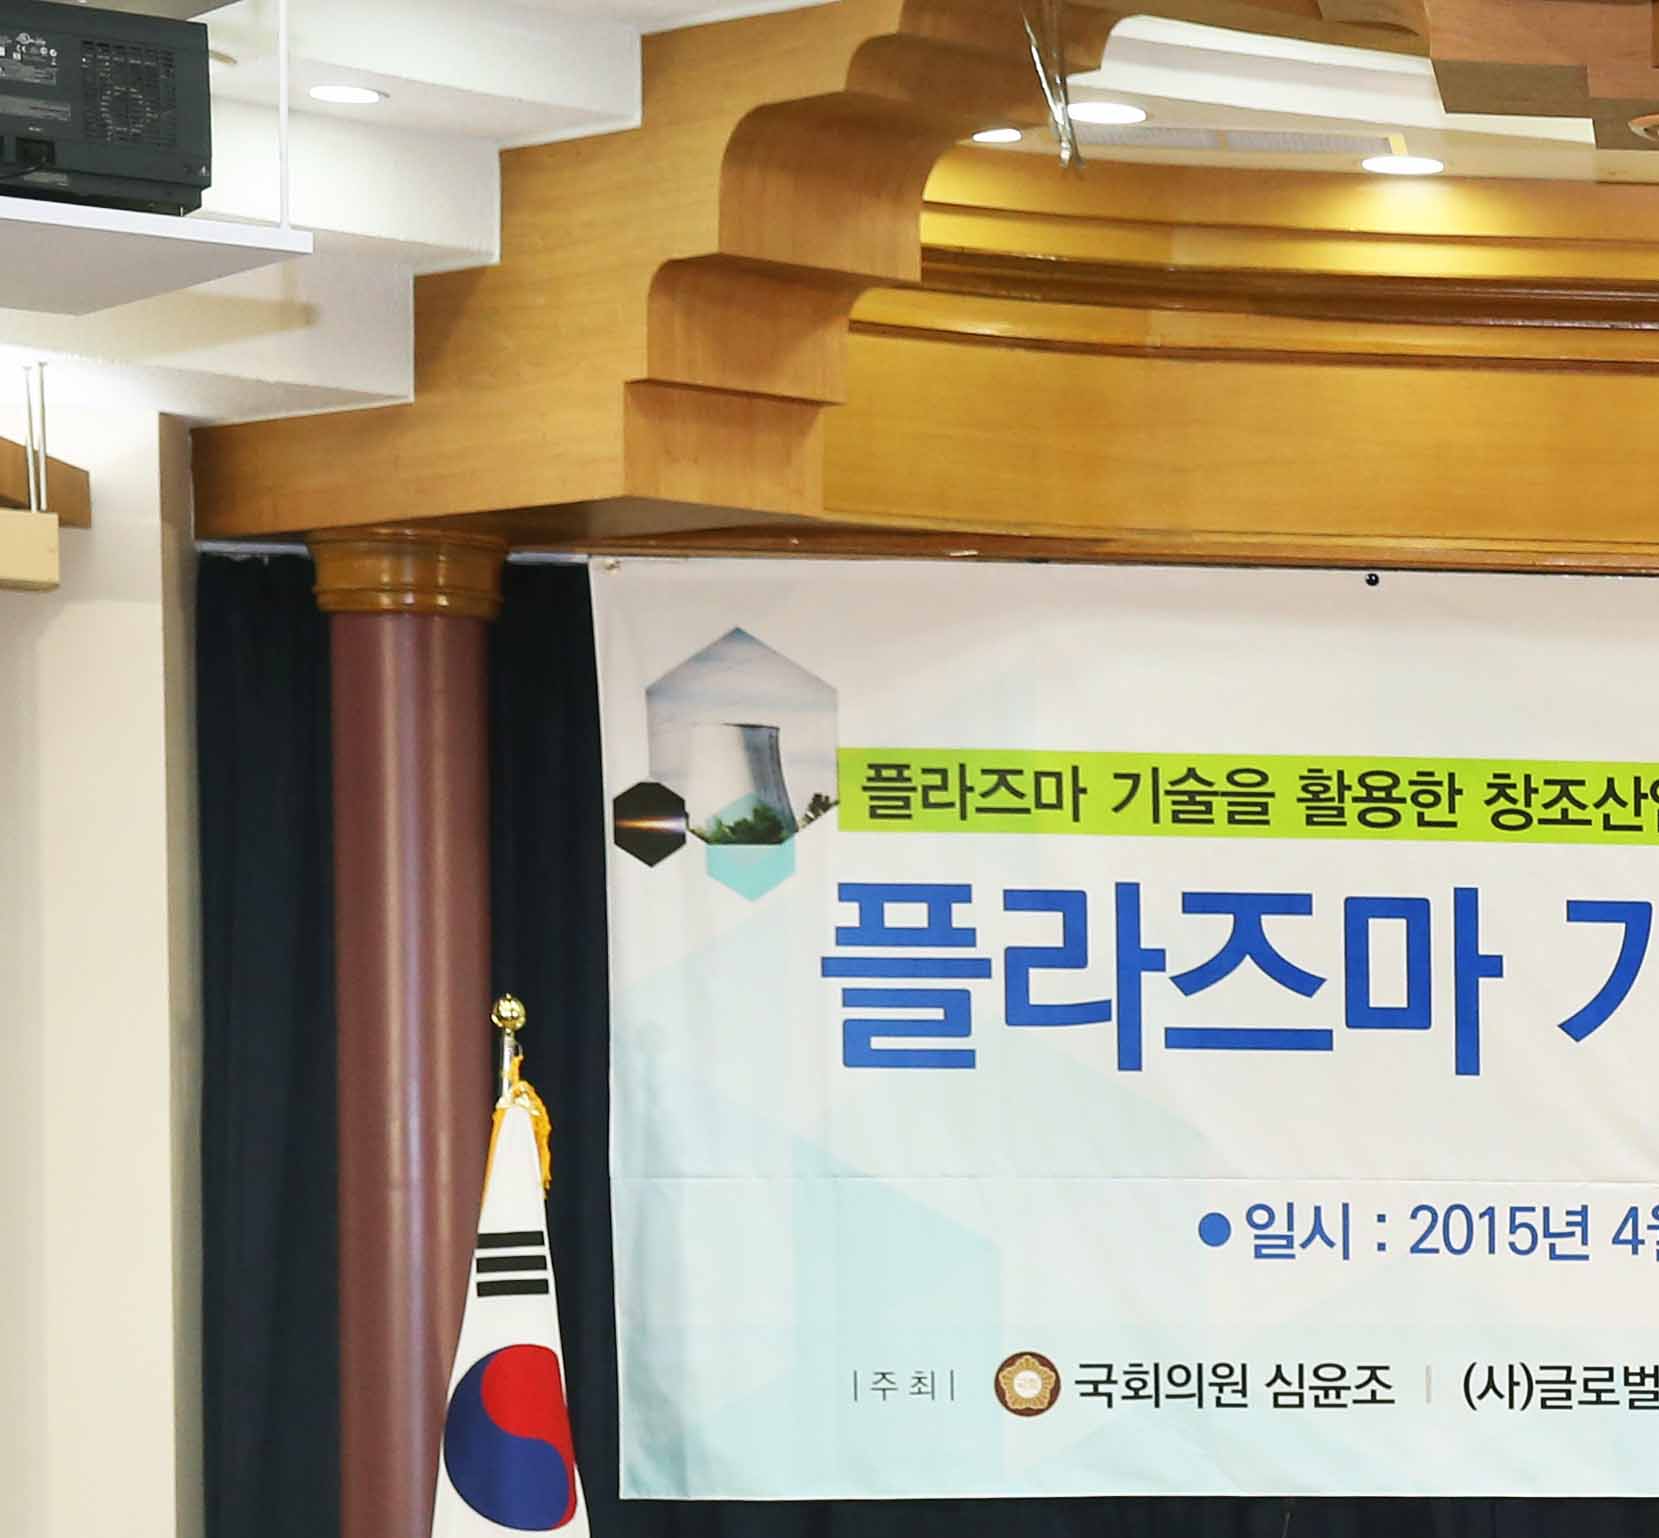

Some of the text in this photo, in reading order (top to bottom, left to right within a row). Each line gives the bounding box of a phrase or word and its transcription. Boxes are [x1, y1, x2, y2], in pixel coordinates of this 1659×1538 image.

[861, 763, 1088, 819] 플라즈마
[1111, 767, 1276, 826] 기술을
[1297, 769, 1463, 828] 활용한
[821, 882, 1504, 1076] 플라즈마
[1246, 1202, 1349, 1260] 일시
[1410, 1204, 1589, 1261] 2015년
[1075, 1362, 1395, 1409] 국회의원 심윤조
